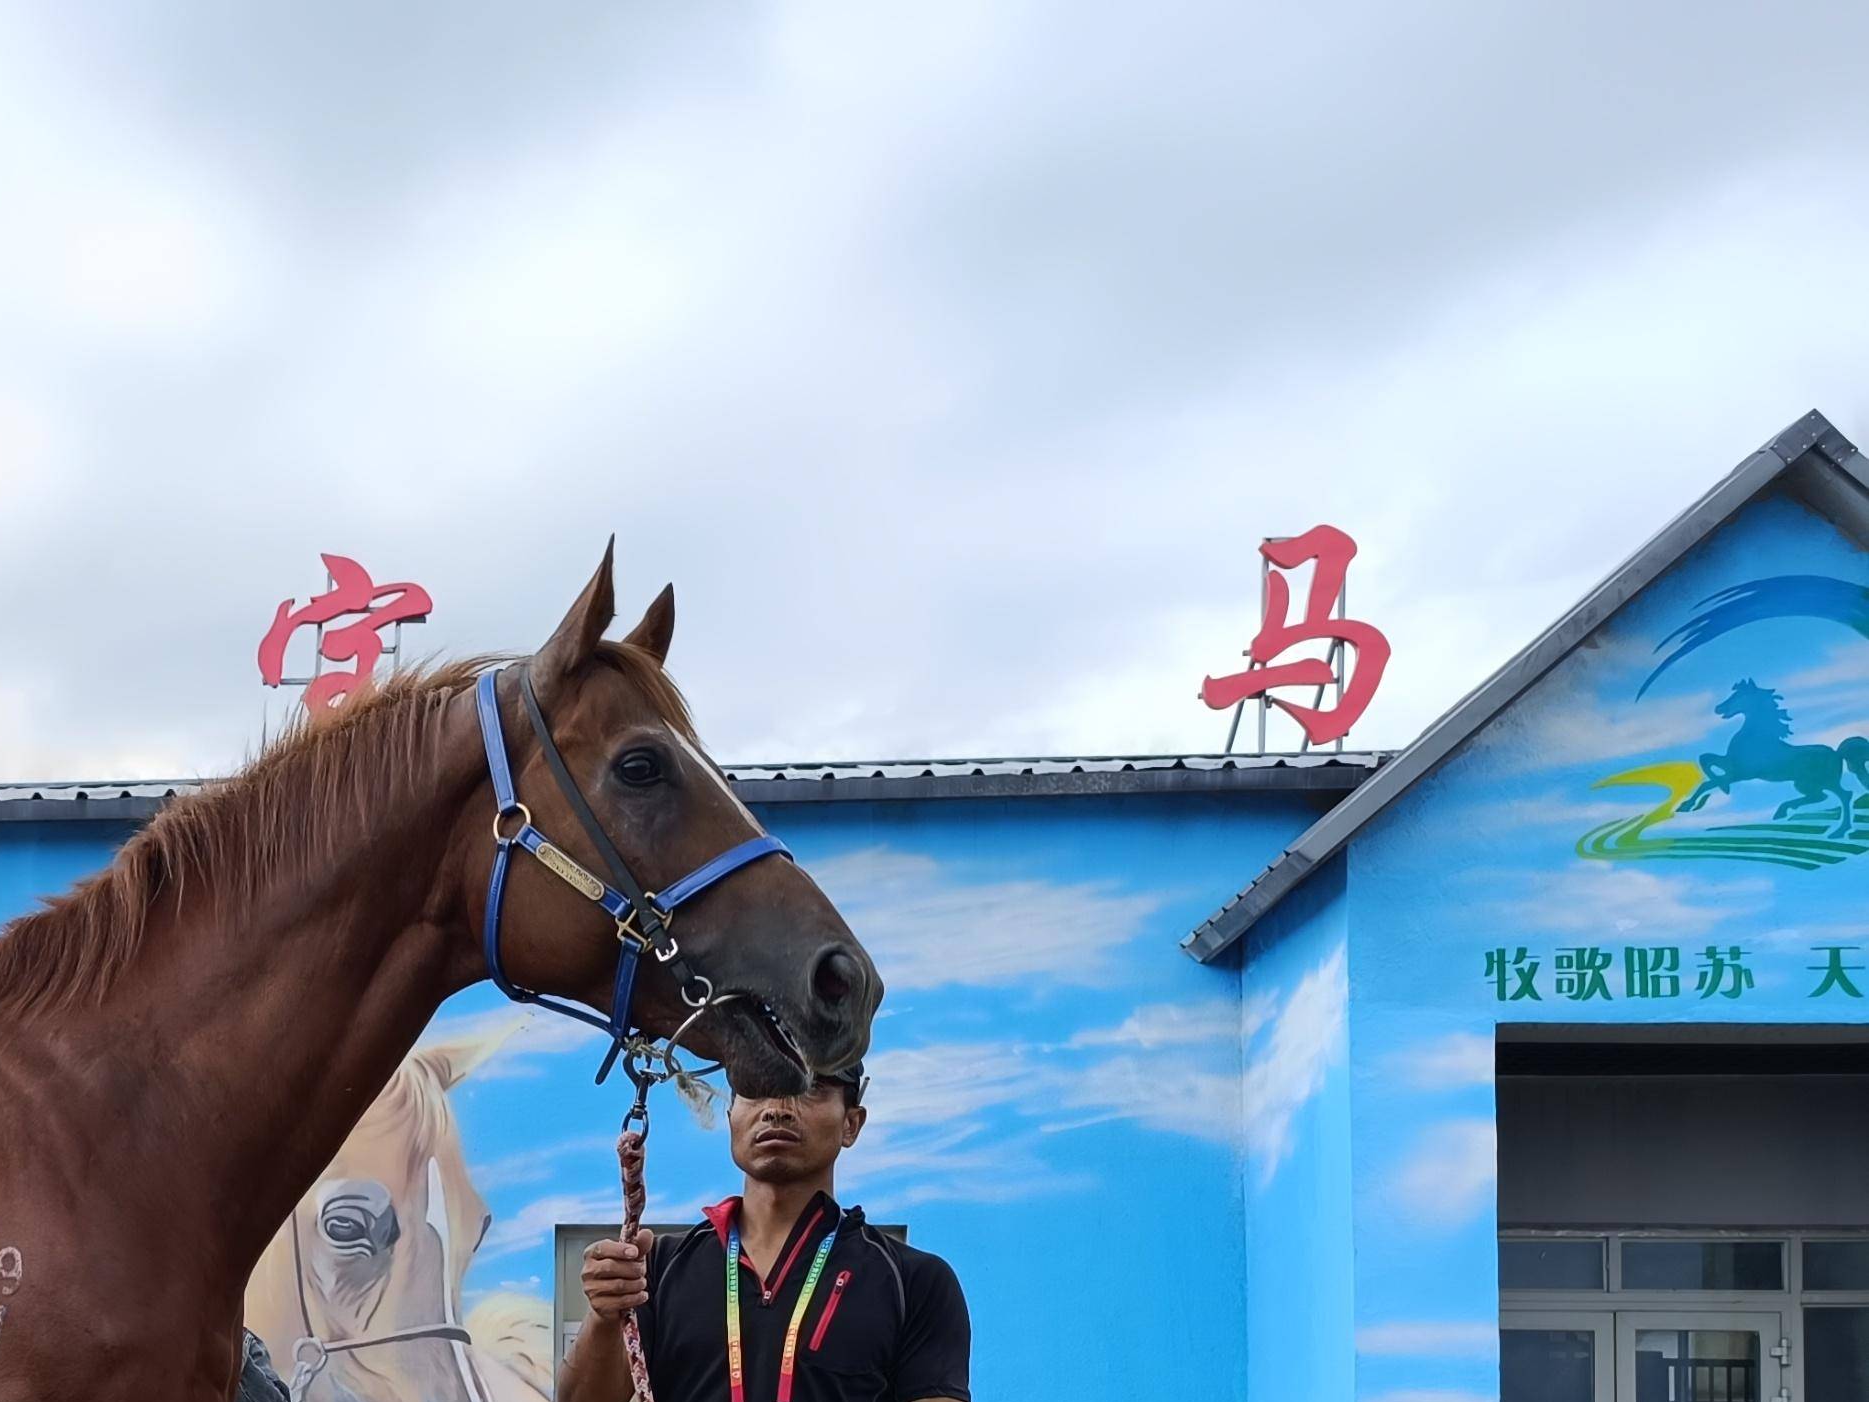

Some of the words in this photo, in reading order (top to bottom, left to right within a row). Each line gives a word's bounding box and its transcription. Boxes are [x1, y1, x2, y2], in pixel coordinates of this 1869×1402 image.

[1201, 524, 1392, 746] 马
[1484, 946, 1755, 1001] 牧歌昭苏
[1806, 946, 1866, 999] 天
